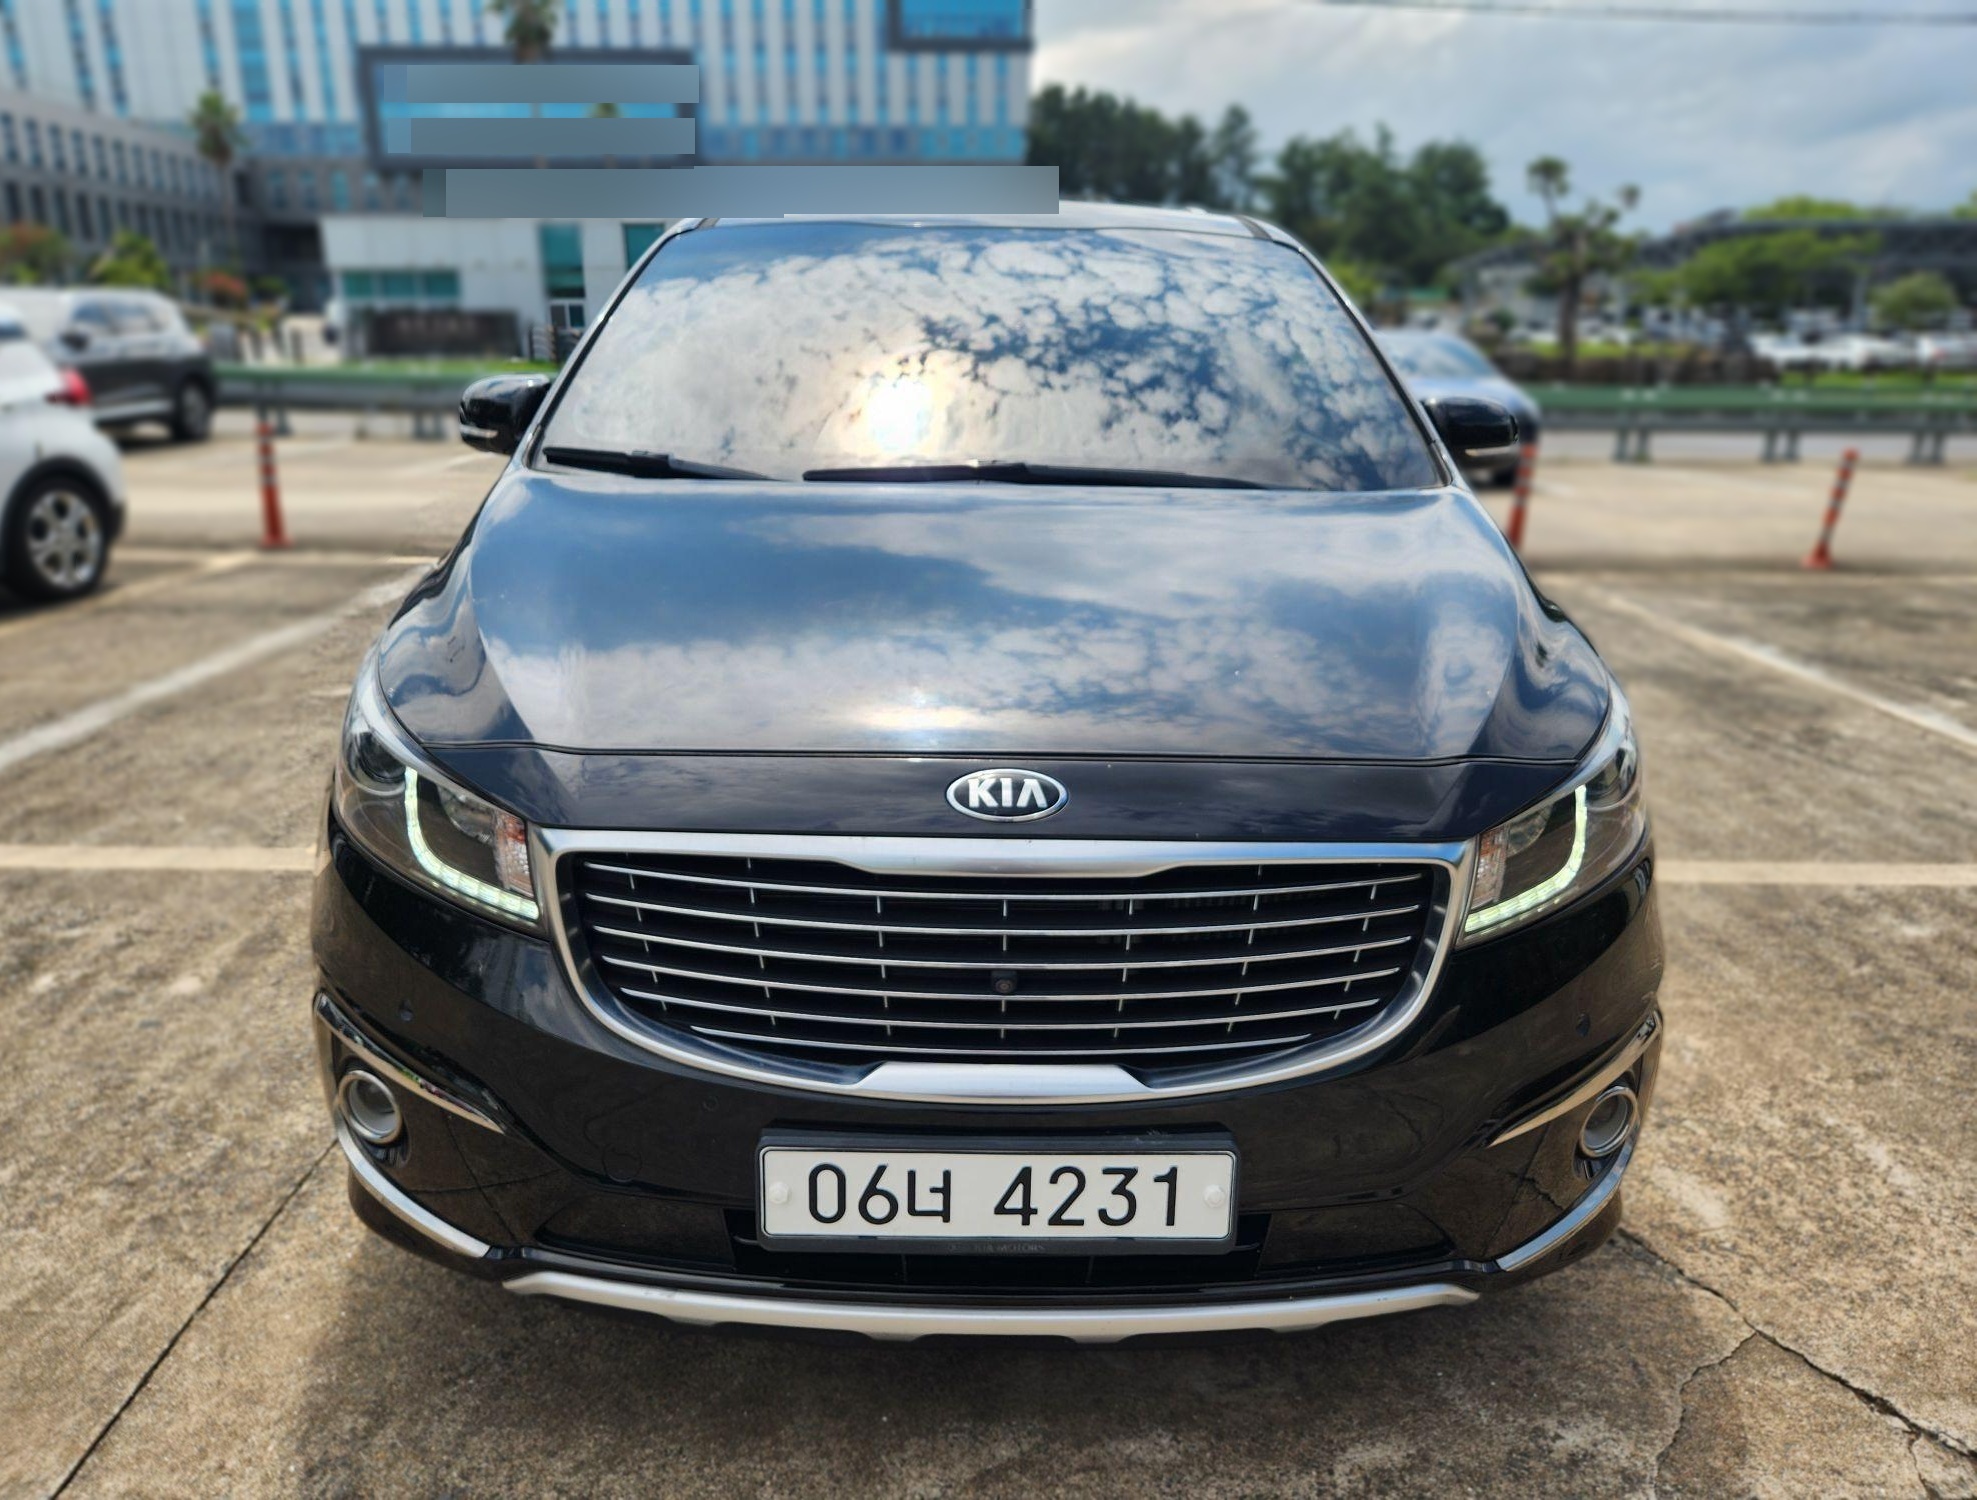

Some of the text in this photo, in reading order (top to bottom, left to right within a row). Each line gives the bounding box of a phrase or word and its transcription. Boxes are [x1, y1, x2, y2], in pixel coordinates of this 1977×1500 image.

[967, 777, 1048, 808] KIA
[808, 1163, 1178, 1226] 06너 4231
